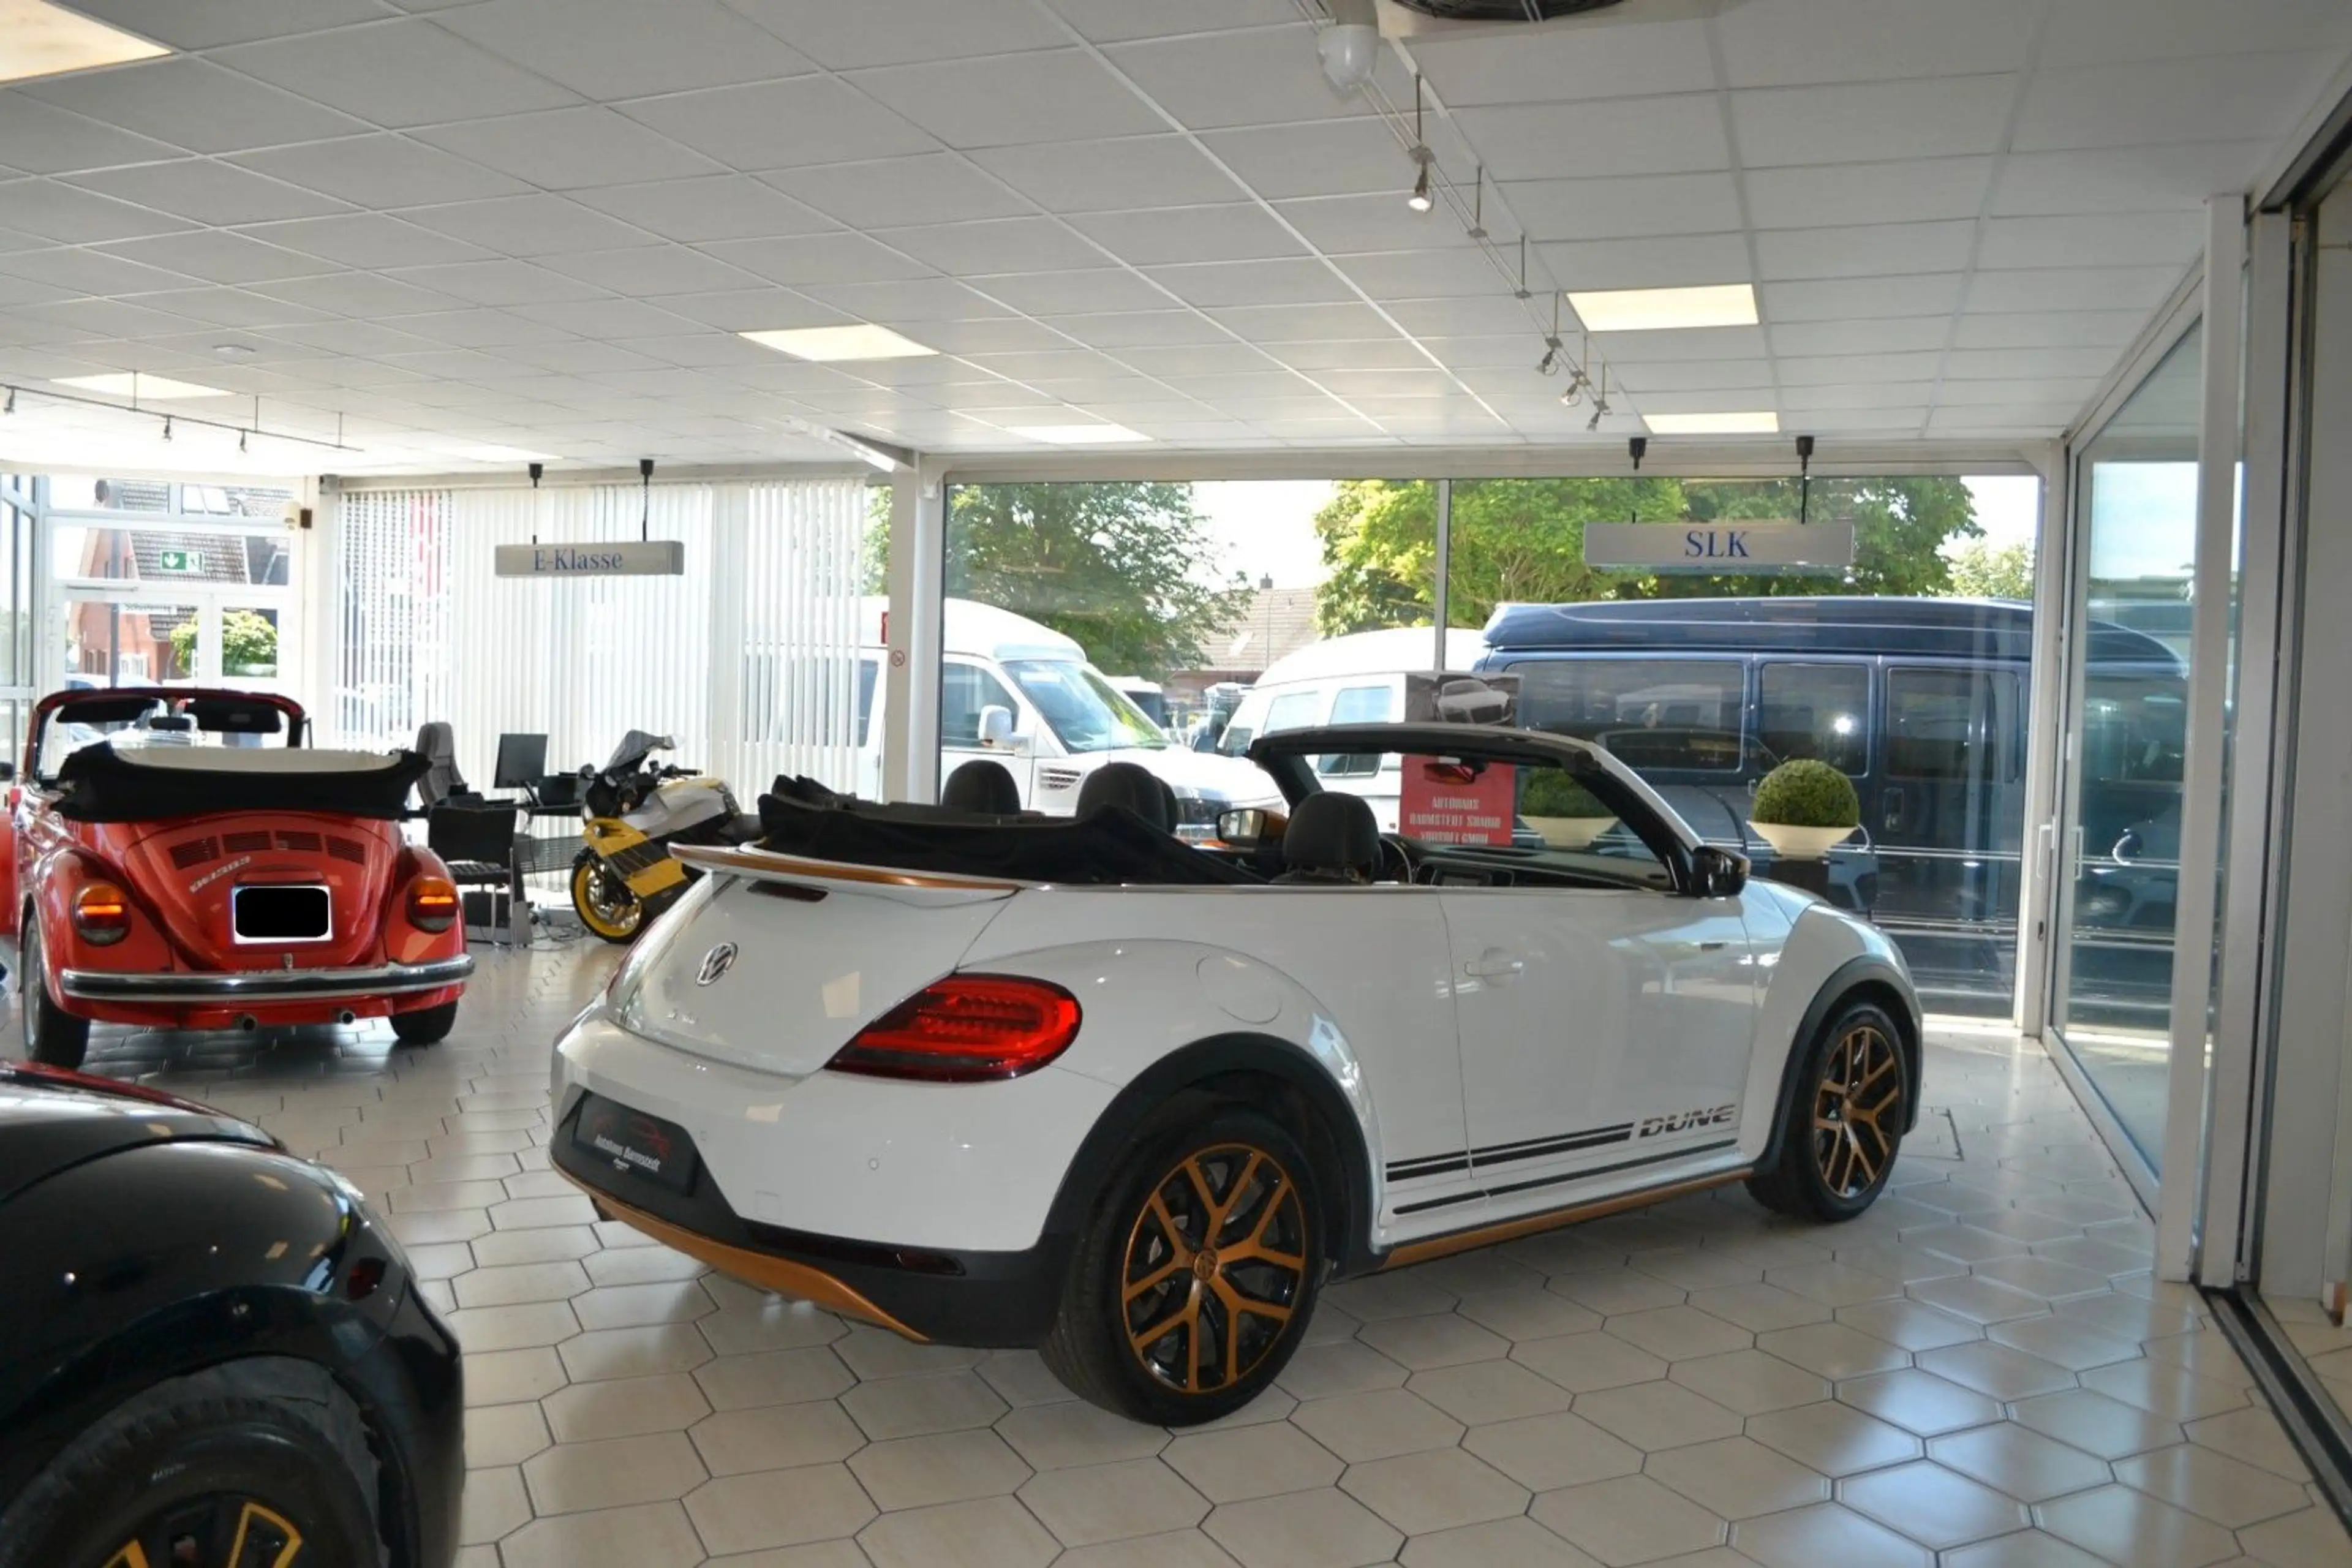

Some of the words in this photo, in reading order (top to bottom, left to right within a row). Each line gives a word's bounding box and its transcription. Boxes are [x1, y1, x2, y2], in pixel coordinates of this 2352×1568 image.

[1684, 530, 1750, 558] SLK
[534, 548, 623, 571] E-Klasse
[1639, 1104, 1736, 1138] DUNE
